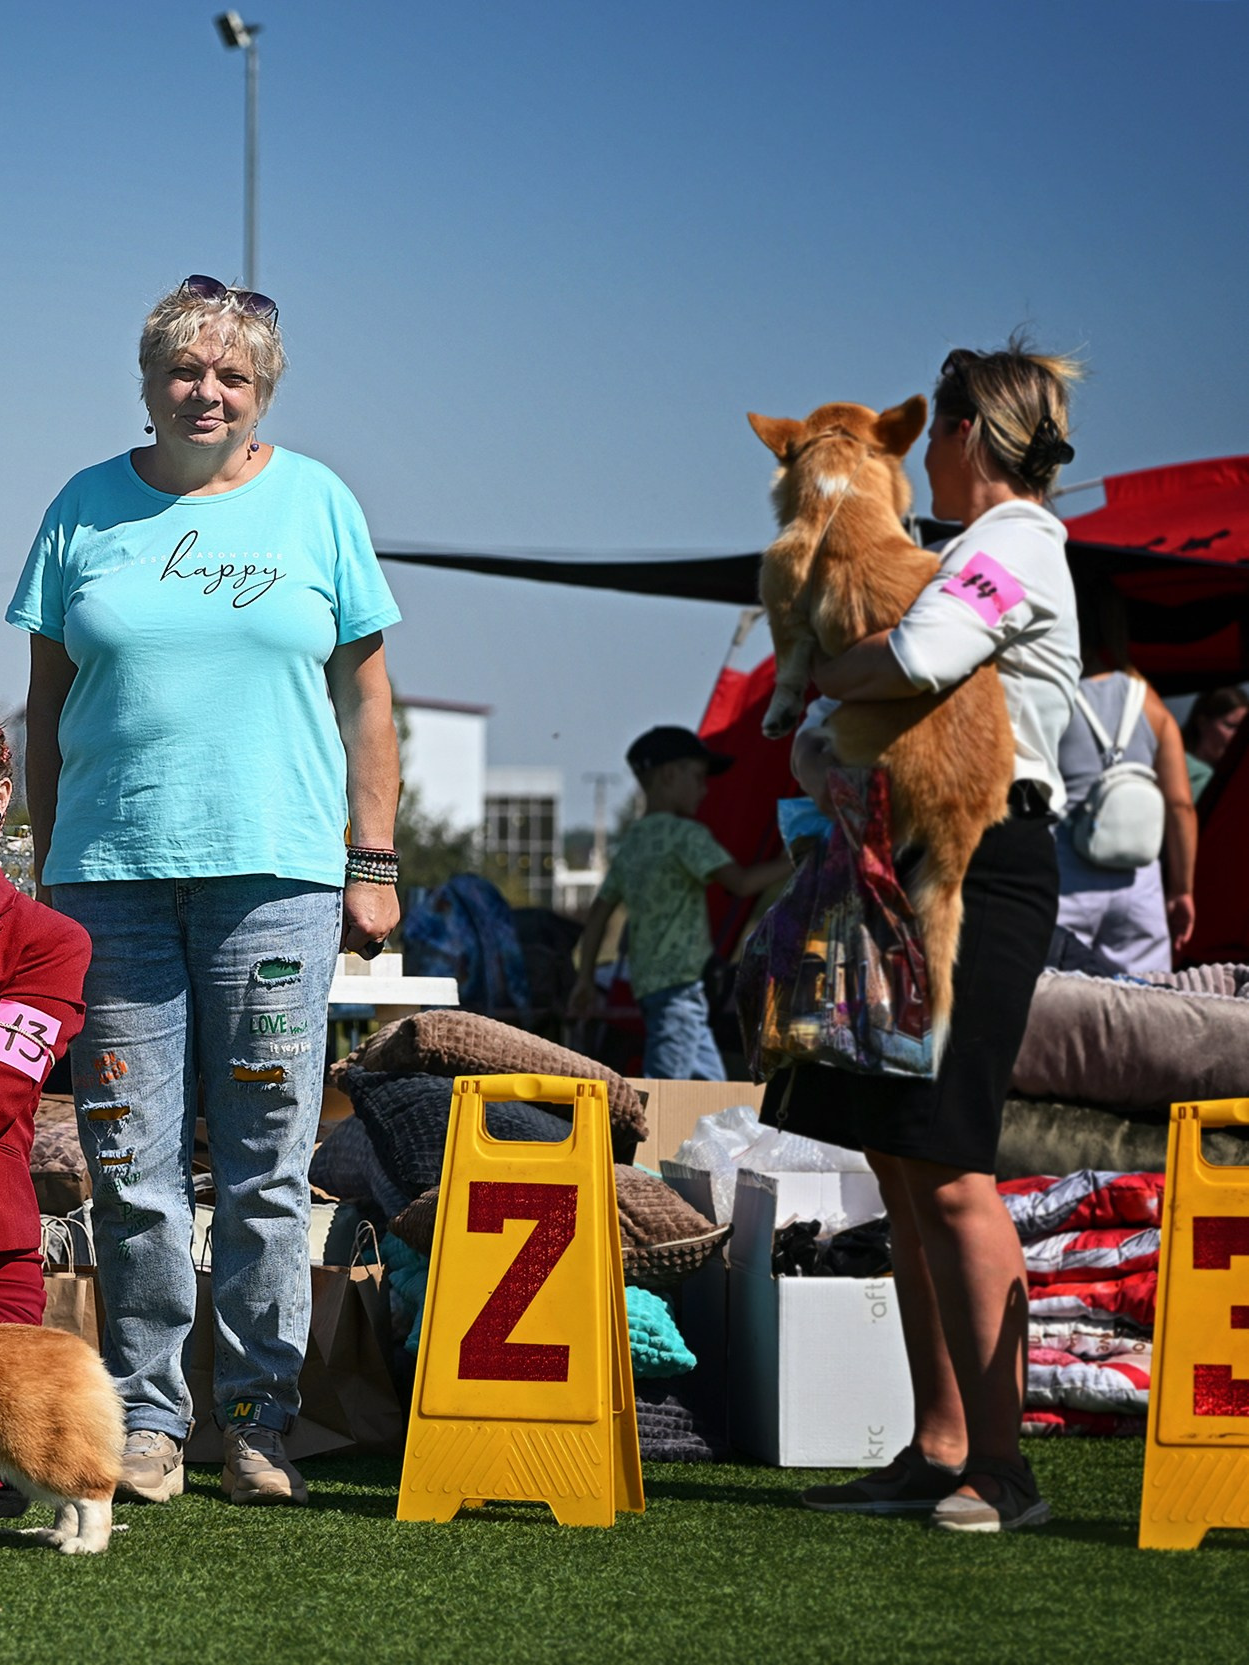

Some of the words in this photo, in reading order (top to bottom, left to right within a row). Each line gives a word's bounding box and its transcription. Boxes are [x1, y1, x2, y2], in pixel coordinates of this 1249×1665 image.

[160, 530, 287, 609] happy
[3, 1013, 48, 1063] 13
[250, 1013, 287, 1034] LOVE
